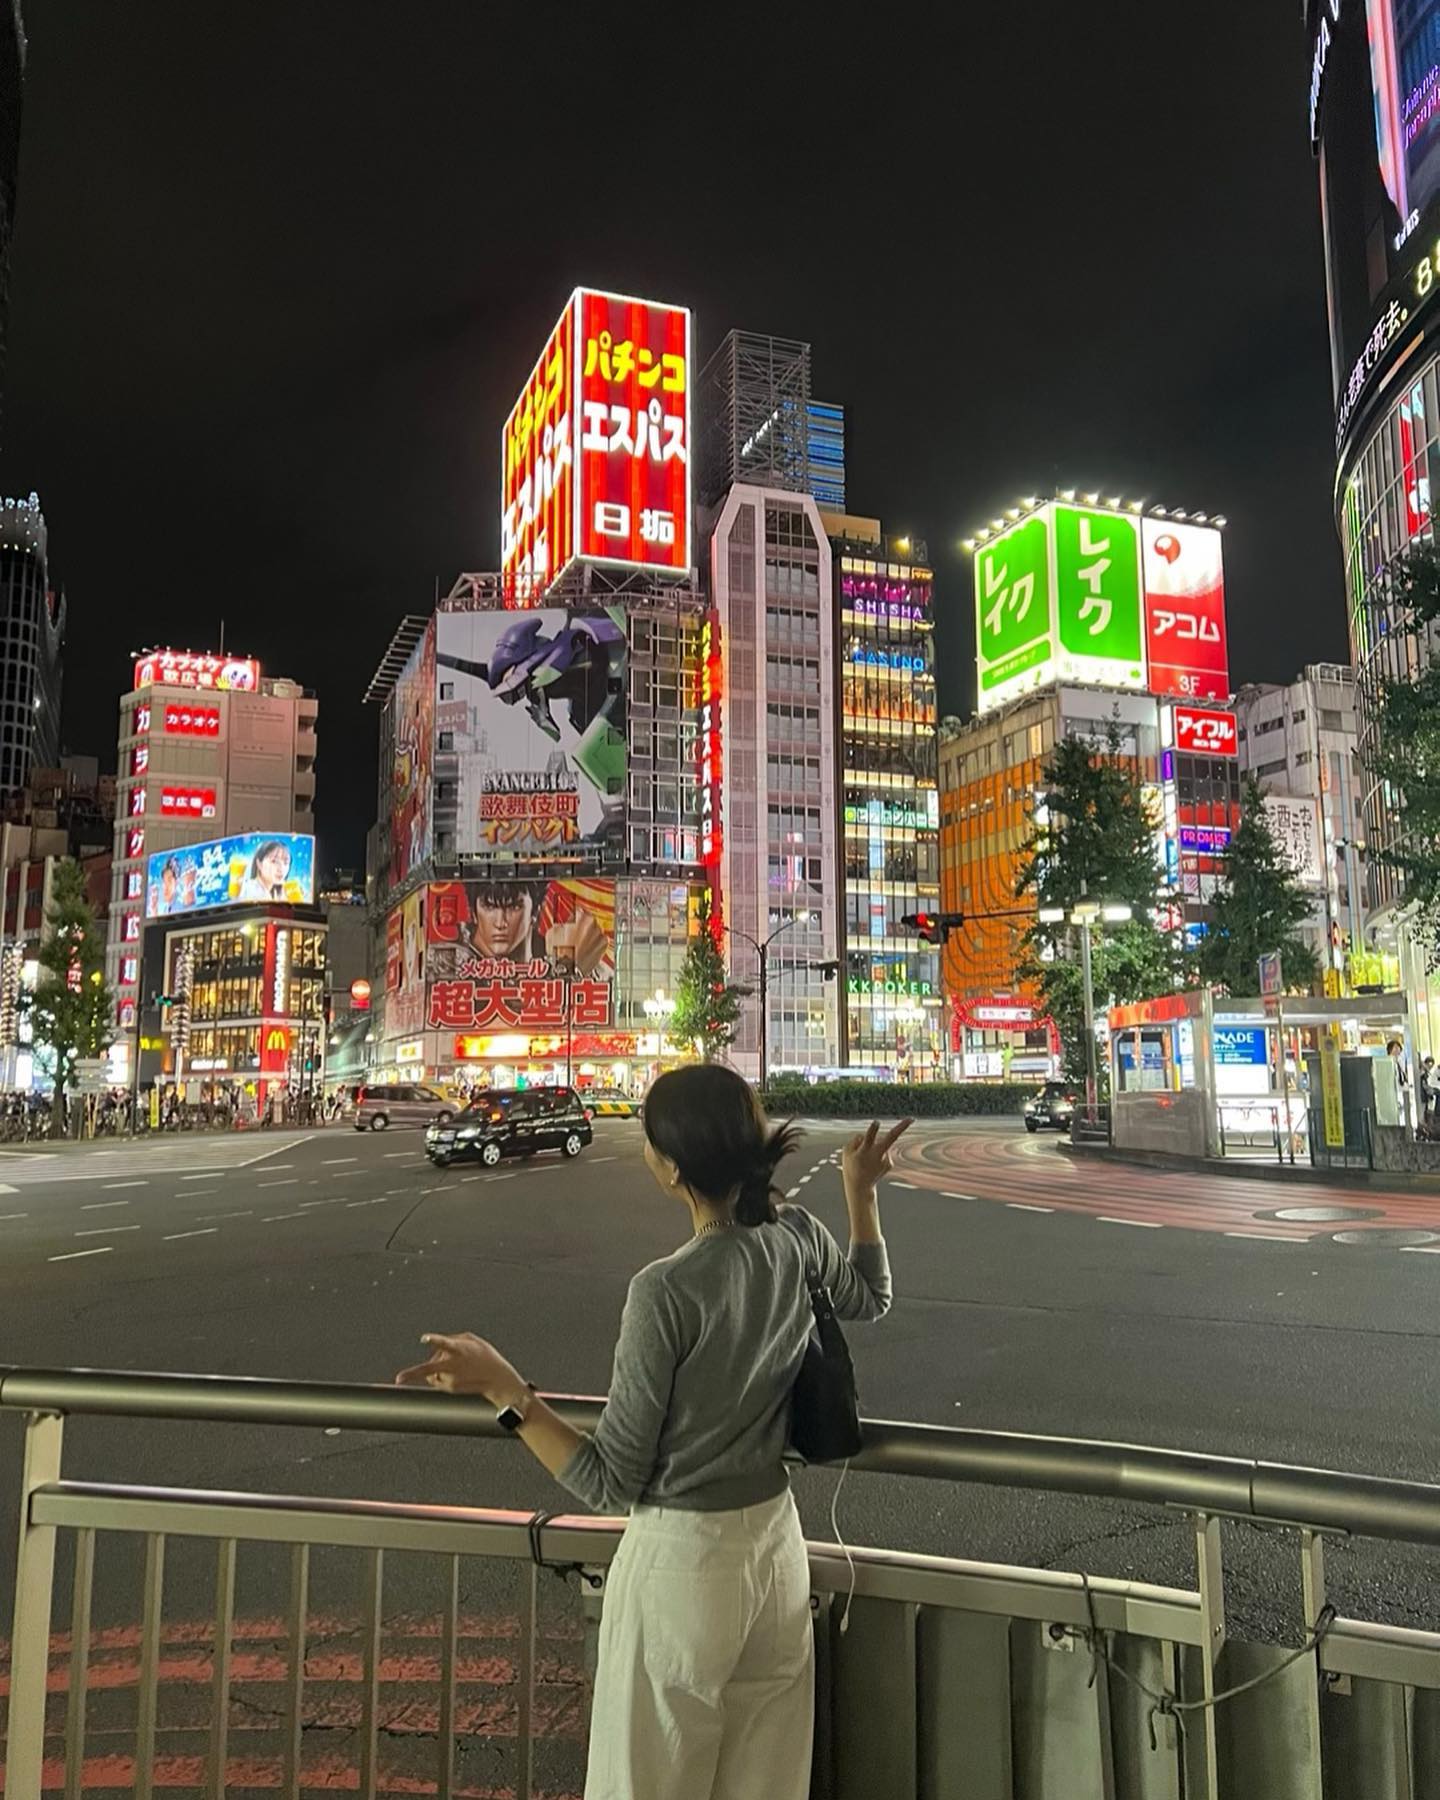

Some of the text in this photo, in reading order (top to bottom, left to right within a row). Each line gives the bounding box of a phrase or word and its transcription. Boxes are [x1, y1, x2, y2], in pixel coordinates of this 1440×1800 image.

[584, 331, 685, 392] パチンコ
[583, 398, 686, 463] エスパス
[595, 502, 675, 544] 日拓
[1078, 518, 1112, 636] レイク
[855, 599, 923, 619] SHISHA
[1153, 610, 1220, 642] アコム
[160, 653, 221, 671] カラオケ
[855, 650, 925, 672] CASINO
[1179, 674, 1200, 693] 3F
[166, 713, 219, 728] カラオケ
[1178, 715, 1234, 739] アイフル
[481, 770, 579, 792] EVANGELION
[480, 793, 580, 820] 歌舞伎町
[480, 817, 581, 845] インパクト
[461, 959, 550, 978] メガホール
[848, 979, 932, 995] KKPOKER
[428, 979, 611, 1028] 超大型店
